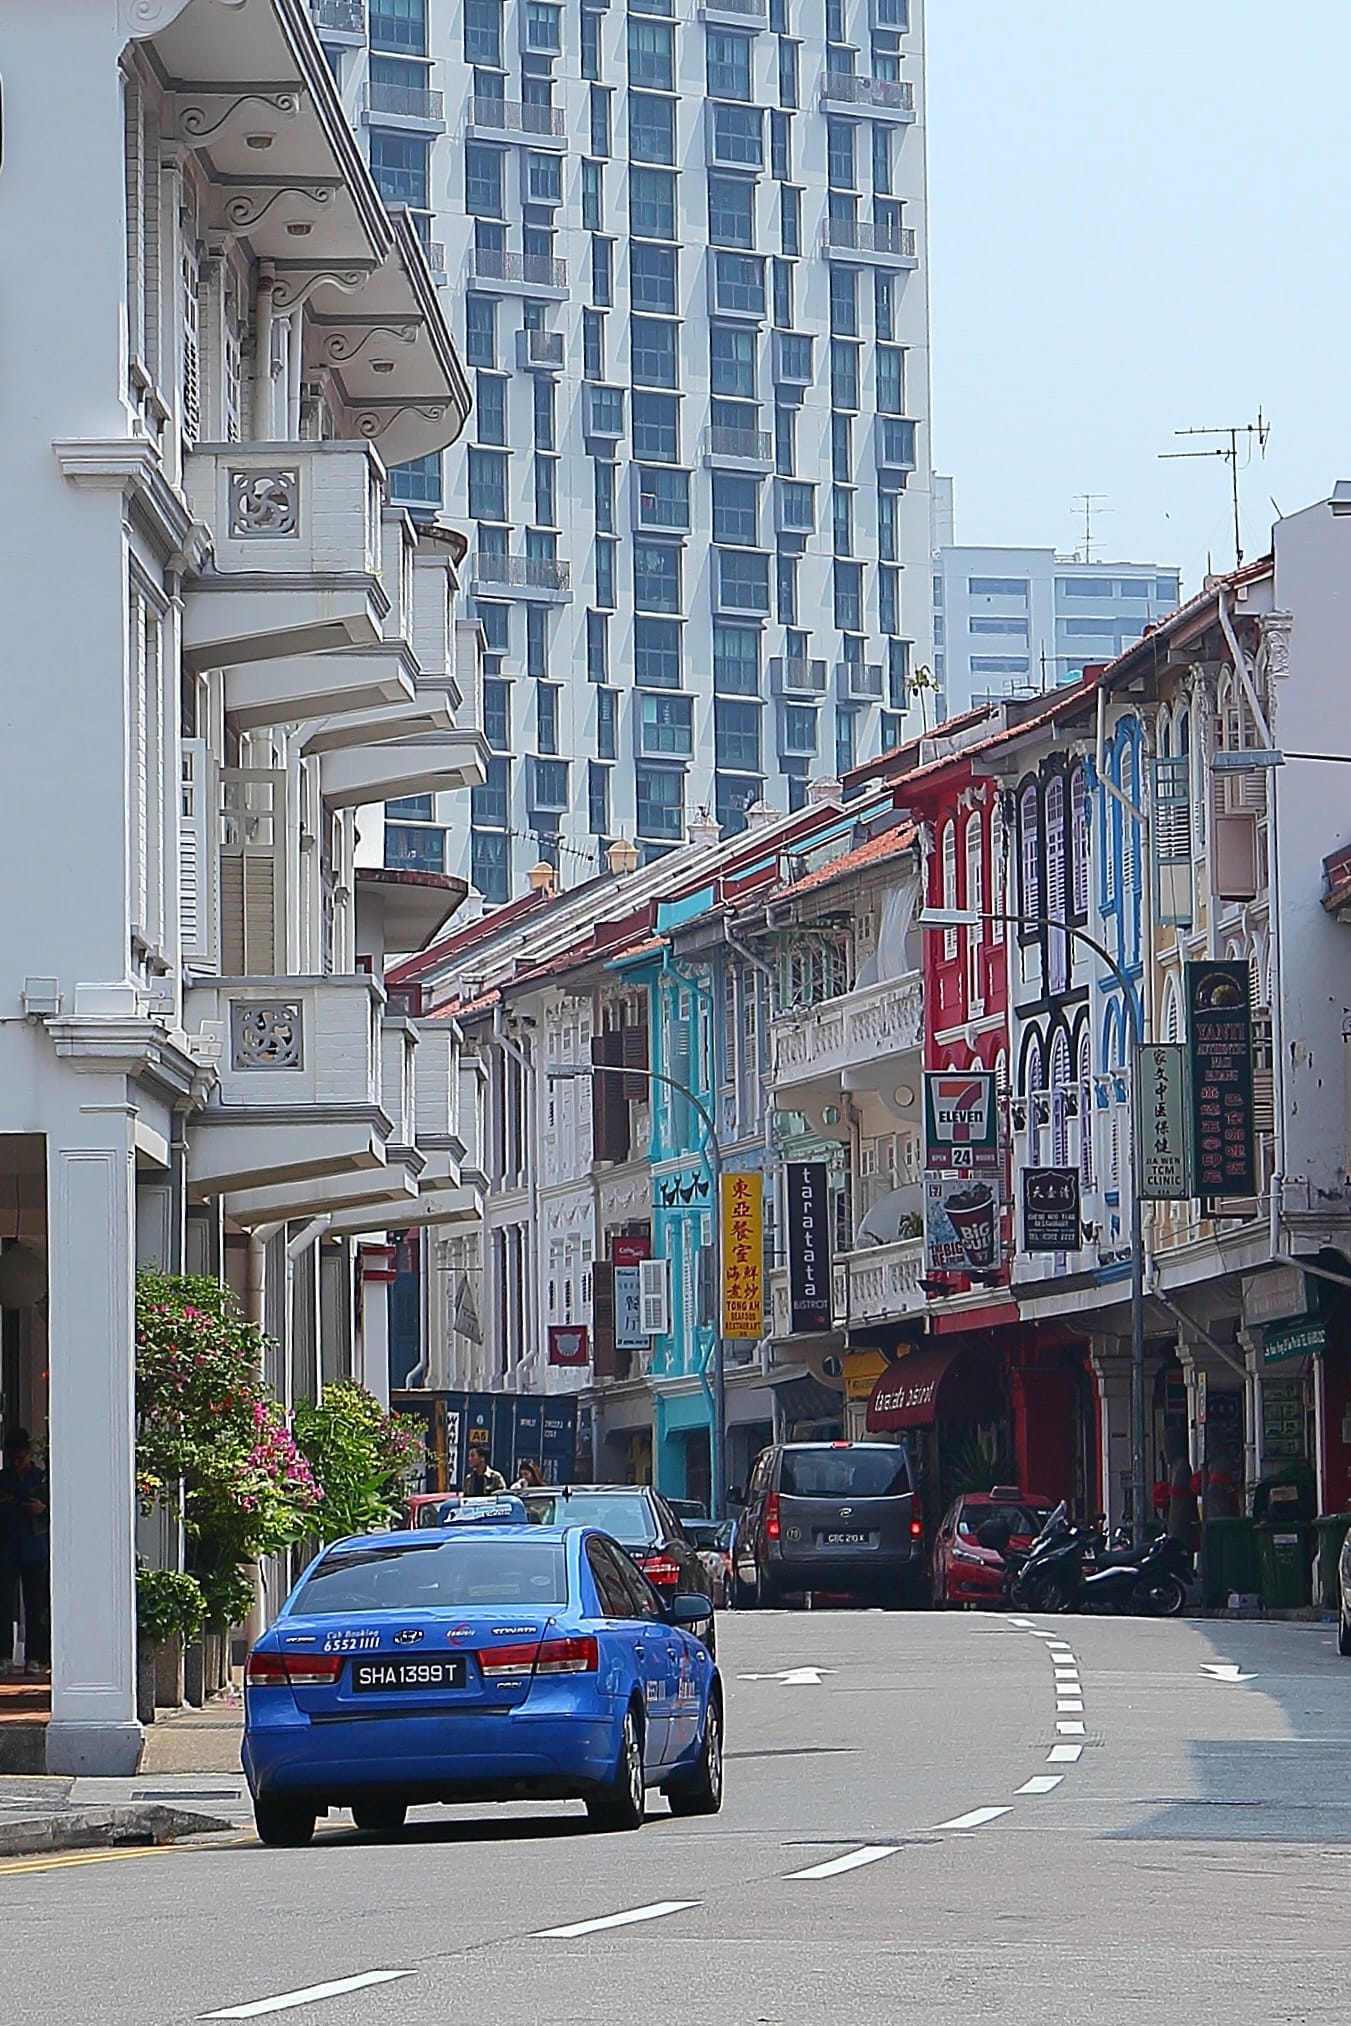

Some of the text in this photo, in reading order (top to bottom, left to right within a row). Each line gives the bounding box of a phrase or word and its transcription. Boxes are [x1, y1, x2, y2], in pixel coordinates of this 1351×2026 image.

[939, 1081, 982, 1141] 7
[953, 1149, 971, 1165] 24
[1151, 1165, 1175, 1175] TCM
[1147, 1175, 1181, 1185] CLINIC
[731, 1178, 754, 1263] 東亞餐室
[802, 1168, 816, 1296] taratata
[943, 1241, 963, 1257] BIG
[726, 1300, 760, 1311] TONG AH
[324, 1638, 357, 1652] 6552
[358, 1637, 380, 1649] 1111
